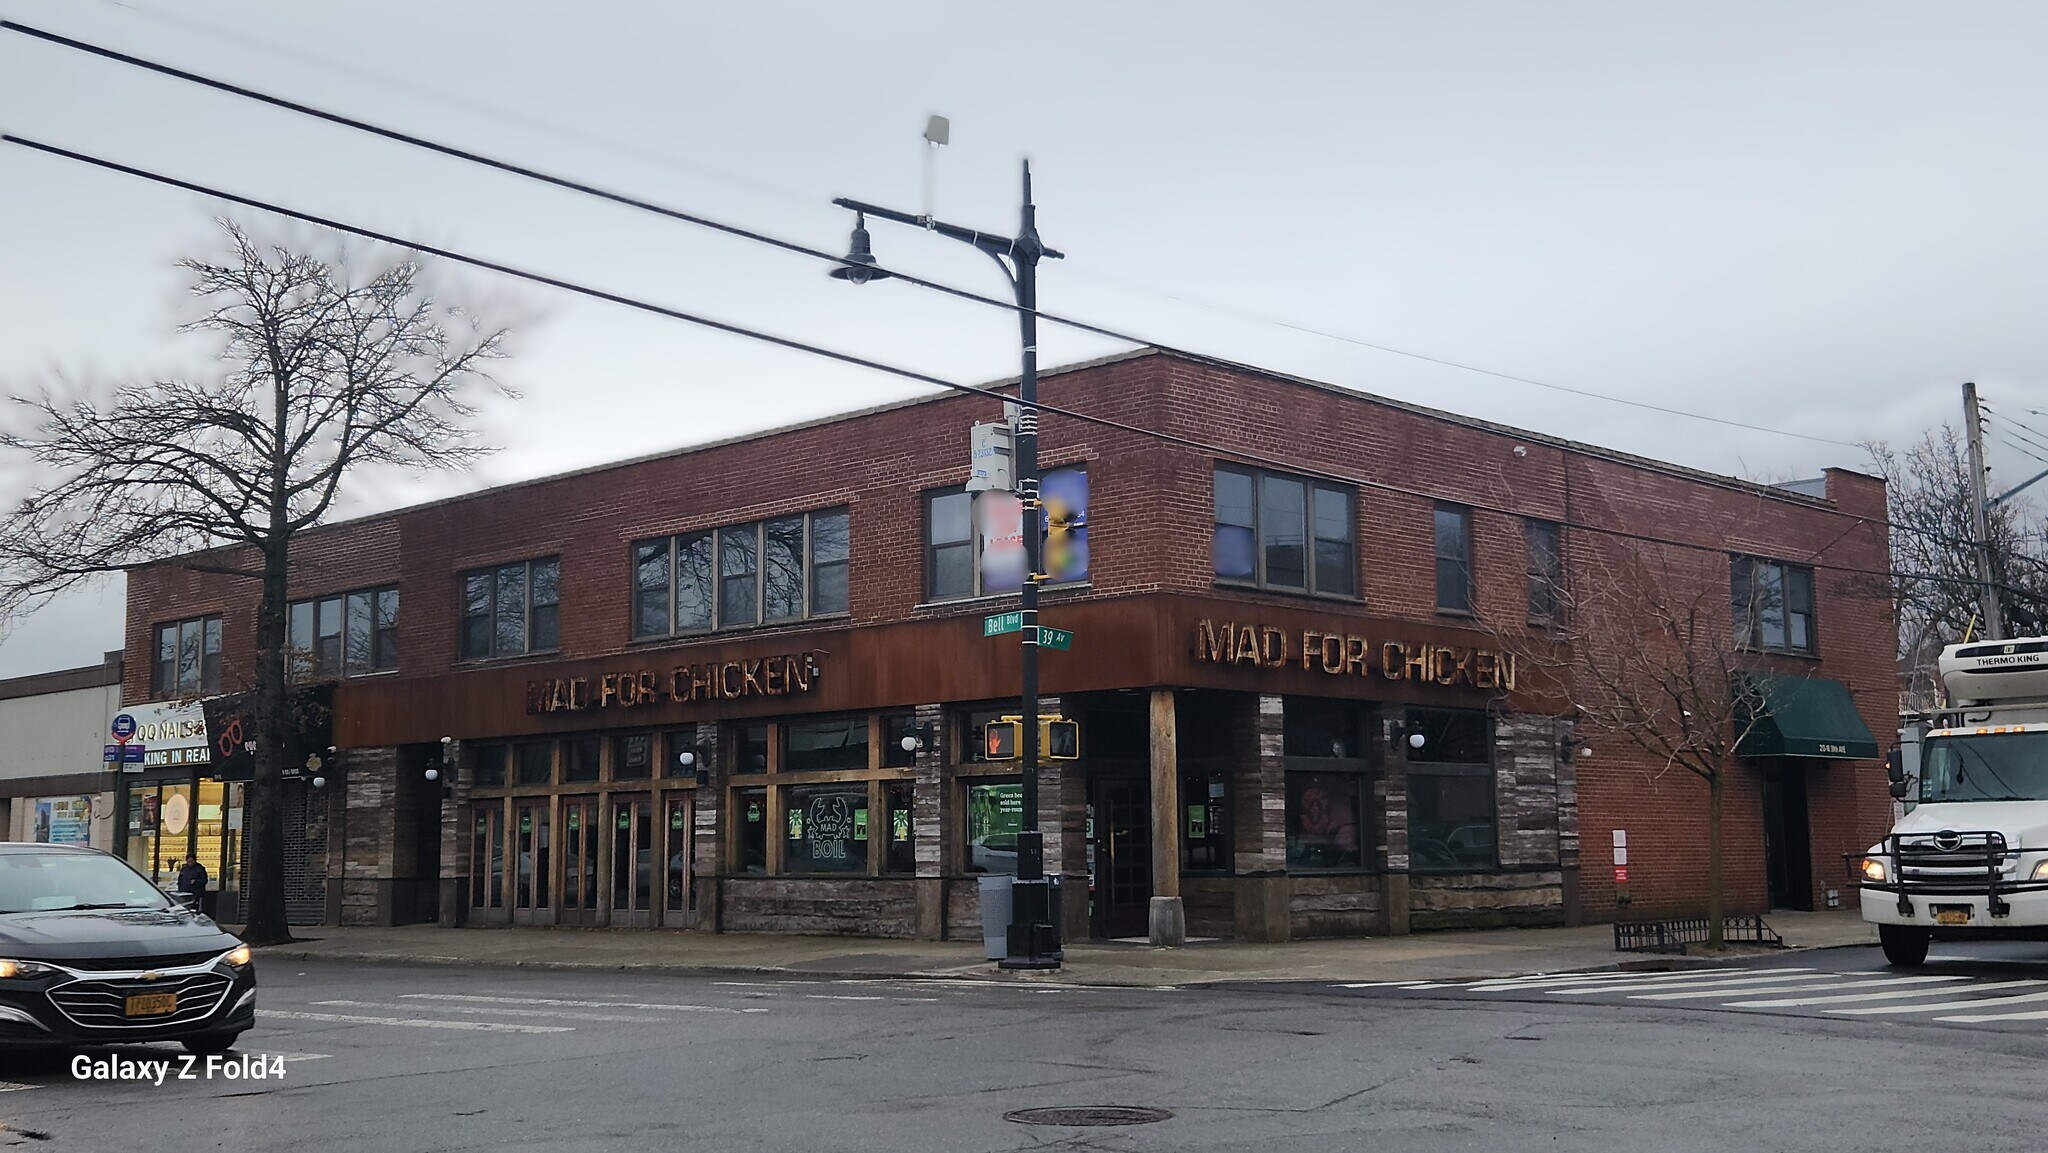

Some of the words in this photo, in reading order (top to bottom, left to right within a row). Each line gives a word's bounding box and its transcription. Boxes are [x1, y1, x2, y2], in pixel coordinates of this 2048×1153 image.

[988, 615, 1004, 633] Bell
[1006, 613, 1019, 625] Blvd
[1042, 629, 1054, 645] 39
[1055, 632, 1066, 642] Av
[1199, 618, 1288, 668] MAD
[1302, 630, 1369, 678] FOR
[1382, 640, 1517, 692] CHICKEN
[1977, 656, 2015, 666] THERMO
[2017, 654, 2040, 663] KING
[526, 676, 589, 716] MAD
[600, 671, 656, 708] FOR
[668, 653, 809, 703] CHICKEN
[137, 723, 156, 742] QQ
[160, 720, 193, 740] NAILS
[144, 750, 168, 766] KING
[171, 749, 181, 763] IN
[820, 823, 837, 832] MAD
[813, 839, 846, 859] BOIL
